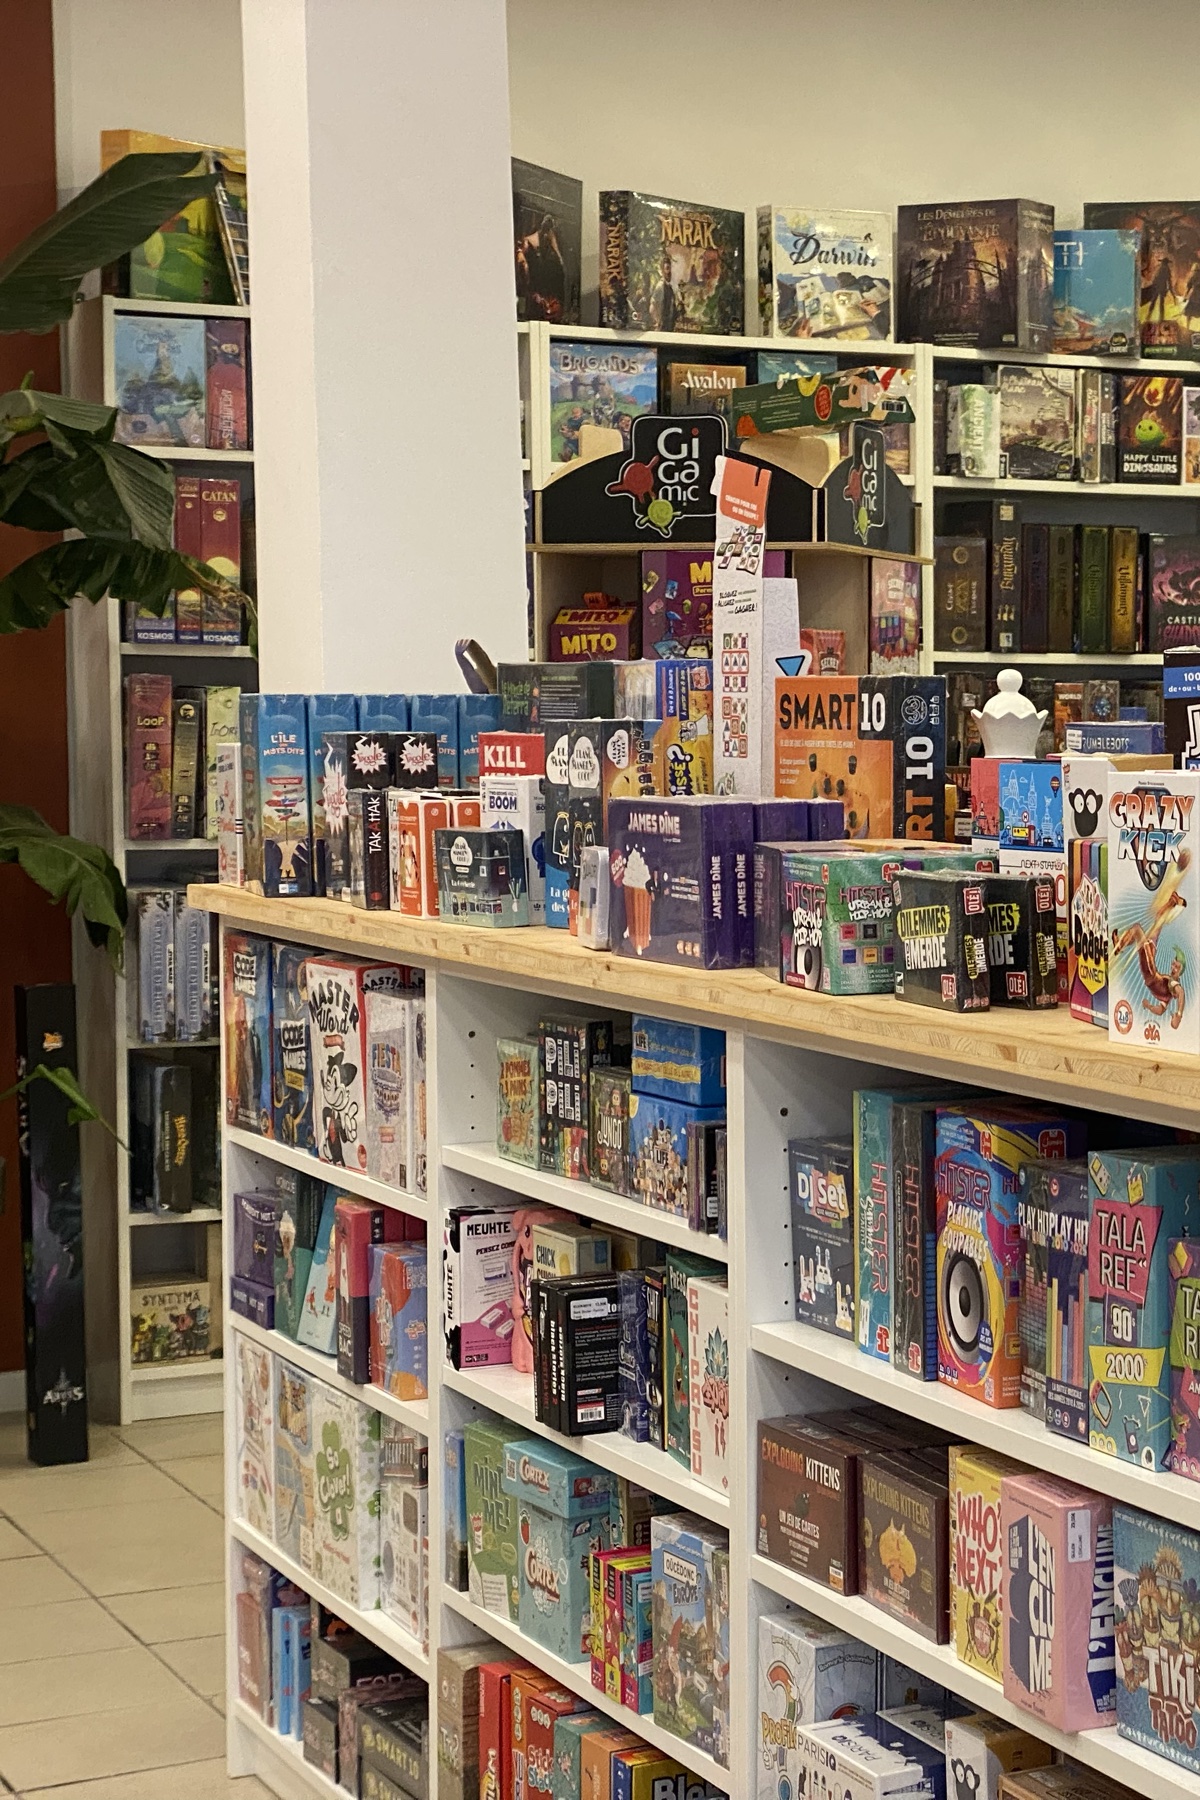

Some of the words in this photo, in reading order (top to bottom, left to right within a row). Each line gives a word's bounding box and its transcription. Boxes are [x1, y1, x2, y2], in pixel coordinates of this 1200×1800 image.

[661, 217, 719, 250] NARAK
[790, 231, 878, 268] Darwin
[559, 352, 640, 375] BRIGANDS
[680, 370, 736, 391] Avalon
[1122, 462, 1178, 474] DINOSAURS
[1123, 453, 1149, 462] HAPPY
[1152, 454, 1178, 463] LITTLE
[202, 491, 236, 502] CATAN
[137, 632, 174, 640] KOSMOS
[203, 634, 239, 642] KOSMOS
[561, 633, 617, 656] MITO
[779, 693, 855, 731] SMART
[861, 692, 886, 732] 10
[484, 745, 526, 769] KILL
[906, 736, 934, 781] 10
[489, 796, 517, 811] BOOM
[1109, 791, 1195, 831] CRAZY
[627, 812, 658, 834] JAMES
[659, 811, 680, 835] DÎNE
[1117, 828, 1186, 862] KICK
[712, 882, 722, 920] JAMES
[737, 890, 746, 917] JAMES
[849, 900, 880, 912] URBAN
[882, 897, 892, 908] &
[969, 889, 980, 912] OLÉ!
[849, 908, 892, 920] HIP-HOP
[900, 906, 948, 935] DILEMMES
[793, 928, 822, 947] HIP-HOP
[234, 955, 255, 976] CODE
[910, 939, 947, 970] MERDE
[1008, 974, 1026, 994] OLÉ!
[310, 979, 360, 1033] MASTER
[281, 1022, 304, 1048] CODE
[315, 1011, 349, 1035] Word
[635, 1034, 647, 1049] LIFE
[948, 1201, 984, 1232] PLAISIRS
[1018, 1202, 1036, 1227] PLAY
[466, 1221, 511, 1236] MEUHTE
[1097, 1211, 1146, 1255] TALA
[476, 1243, 499, 1255] PENSEZ
[536, 1244, 556, 1269] CHICK
[942, 1228, 988, 1262] COUPABLES
[519, 1456, 550, 1486] CORTEX
[761, 1436, 804, 1477] EXPLODING
[805, 1456, 840, 1491] KITTENS
[787, 1511, 795, 1527] JEU
[795, 1515, 800, 1529] DE
[801, 1517, 820, 1539] CARTES
[524, 1547, 560, 1594] CORTEX
[956, 1544, 999, 1597] NEXT
[1029, 1634, 1053, 1693] ME
[1149, 1696, 1198, 1749] TATOO
